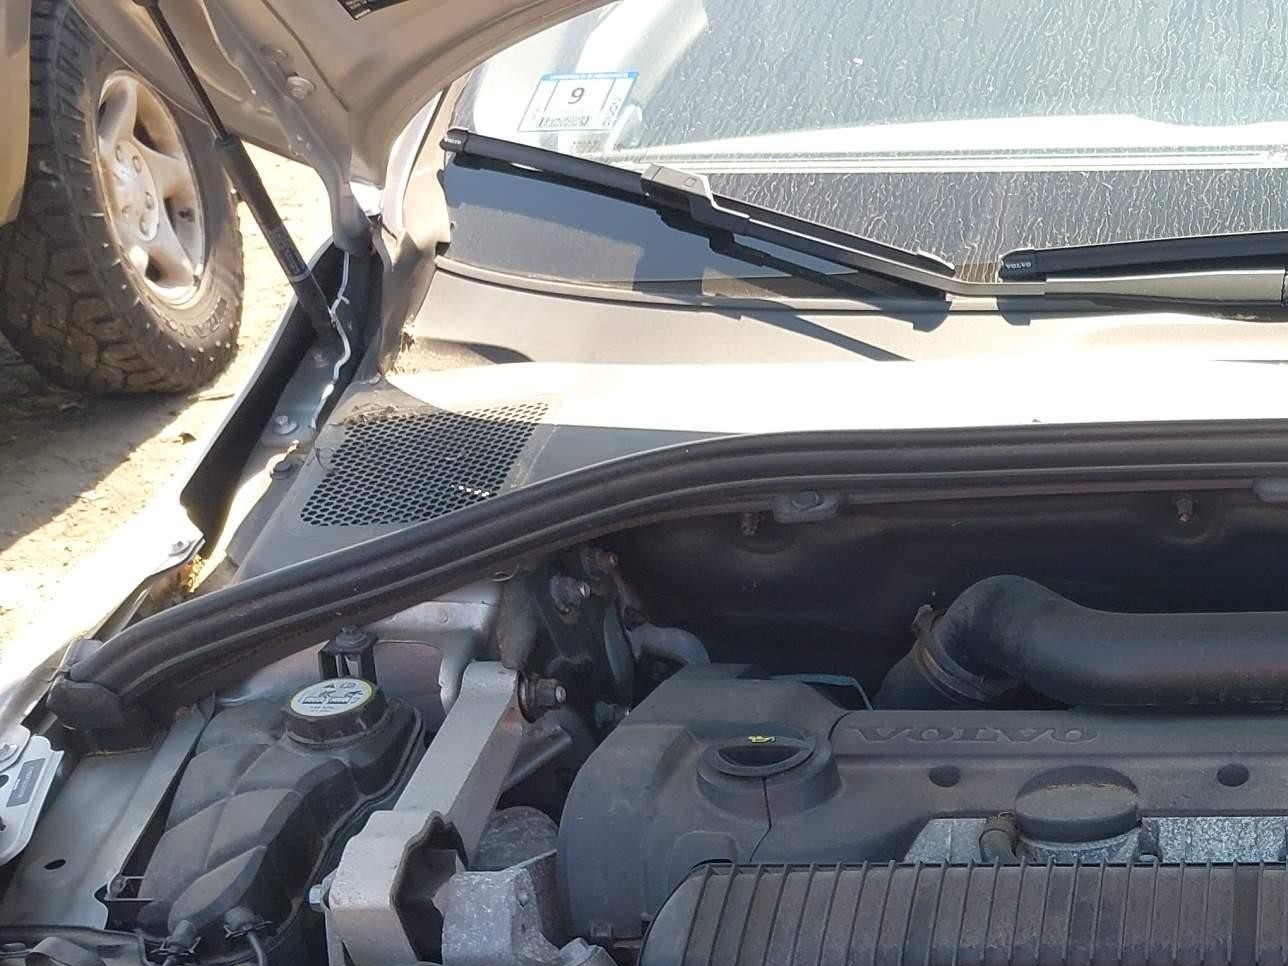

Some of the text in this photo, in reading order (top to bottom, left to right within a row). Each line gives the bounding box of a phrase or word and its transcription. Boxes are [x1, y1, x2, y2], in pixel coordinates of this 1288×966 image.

[568, 87, 585, 105] 9
[1005, 261, 1032, 269] VOLVO
[846, 726, 1100, 744] VOLVO
